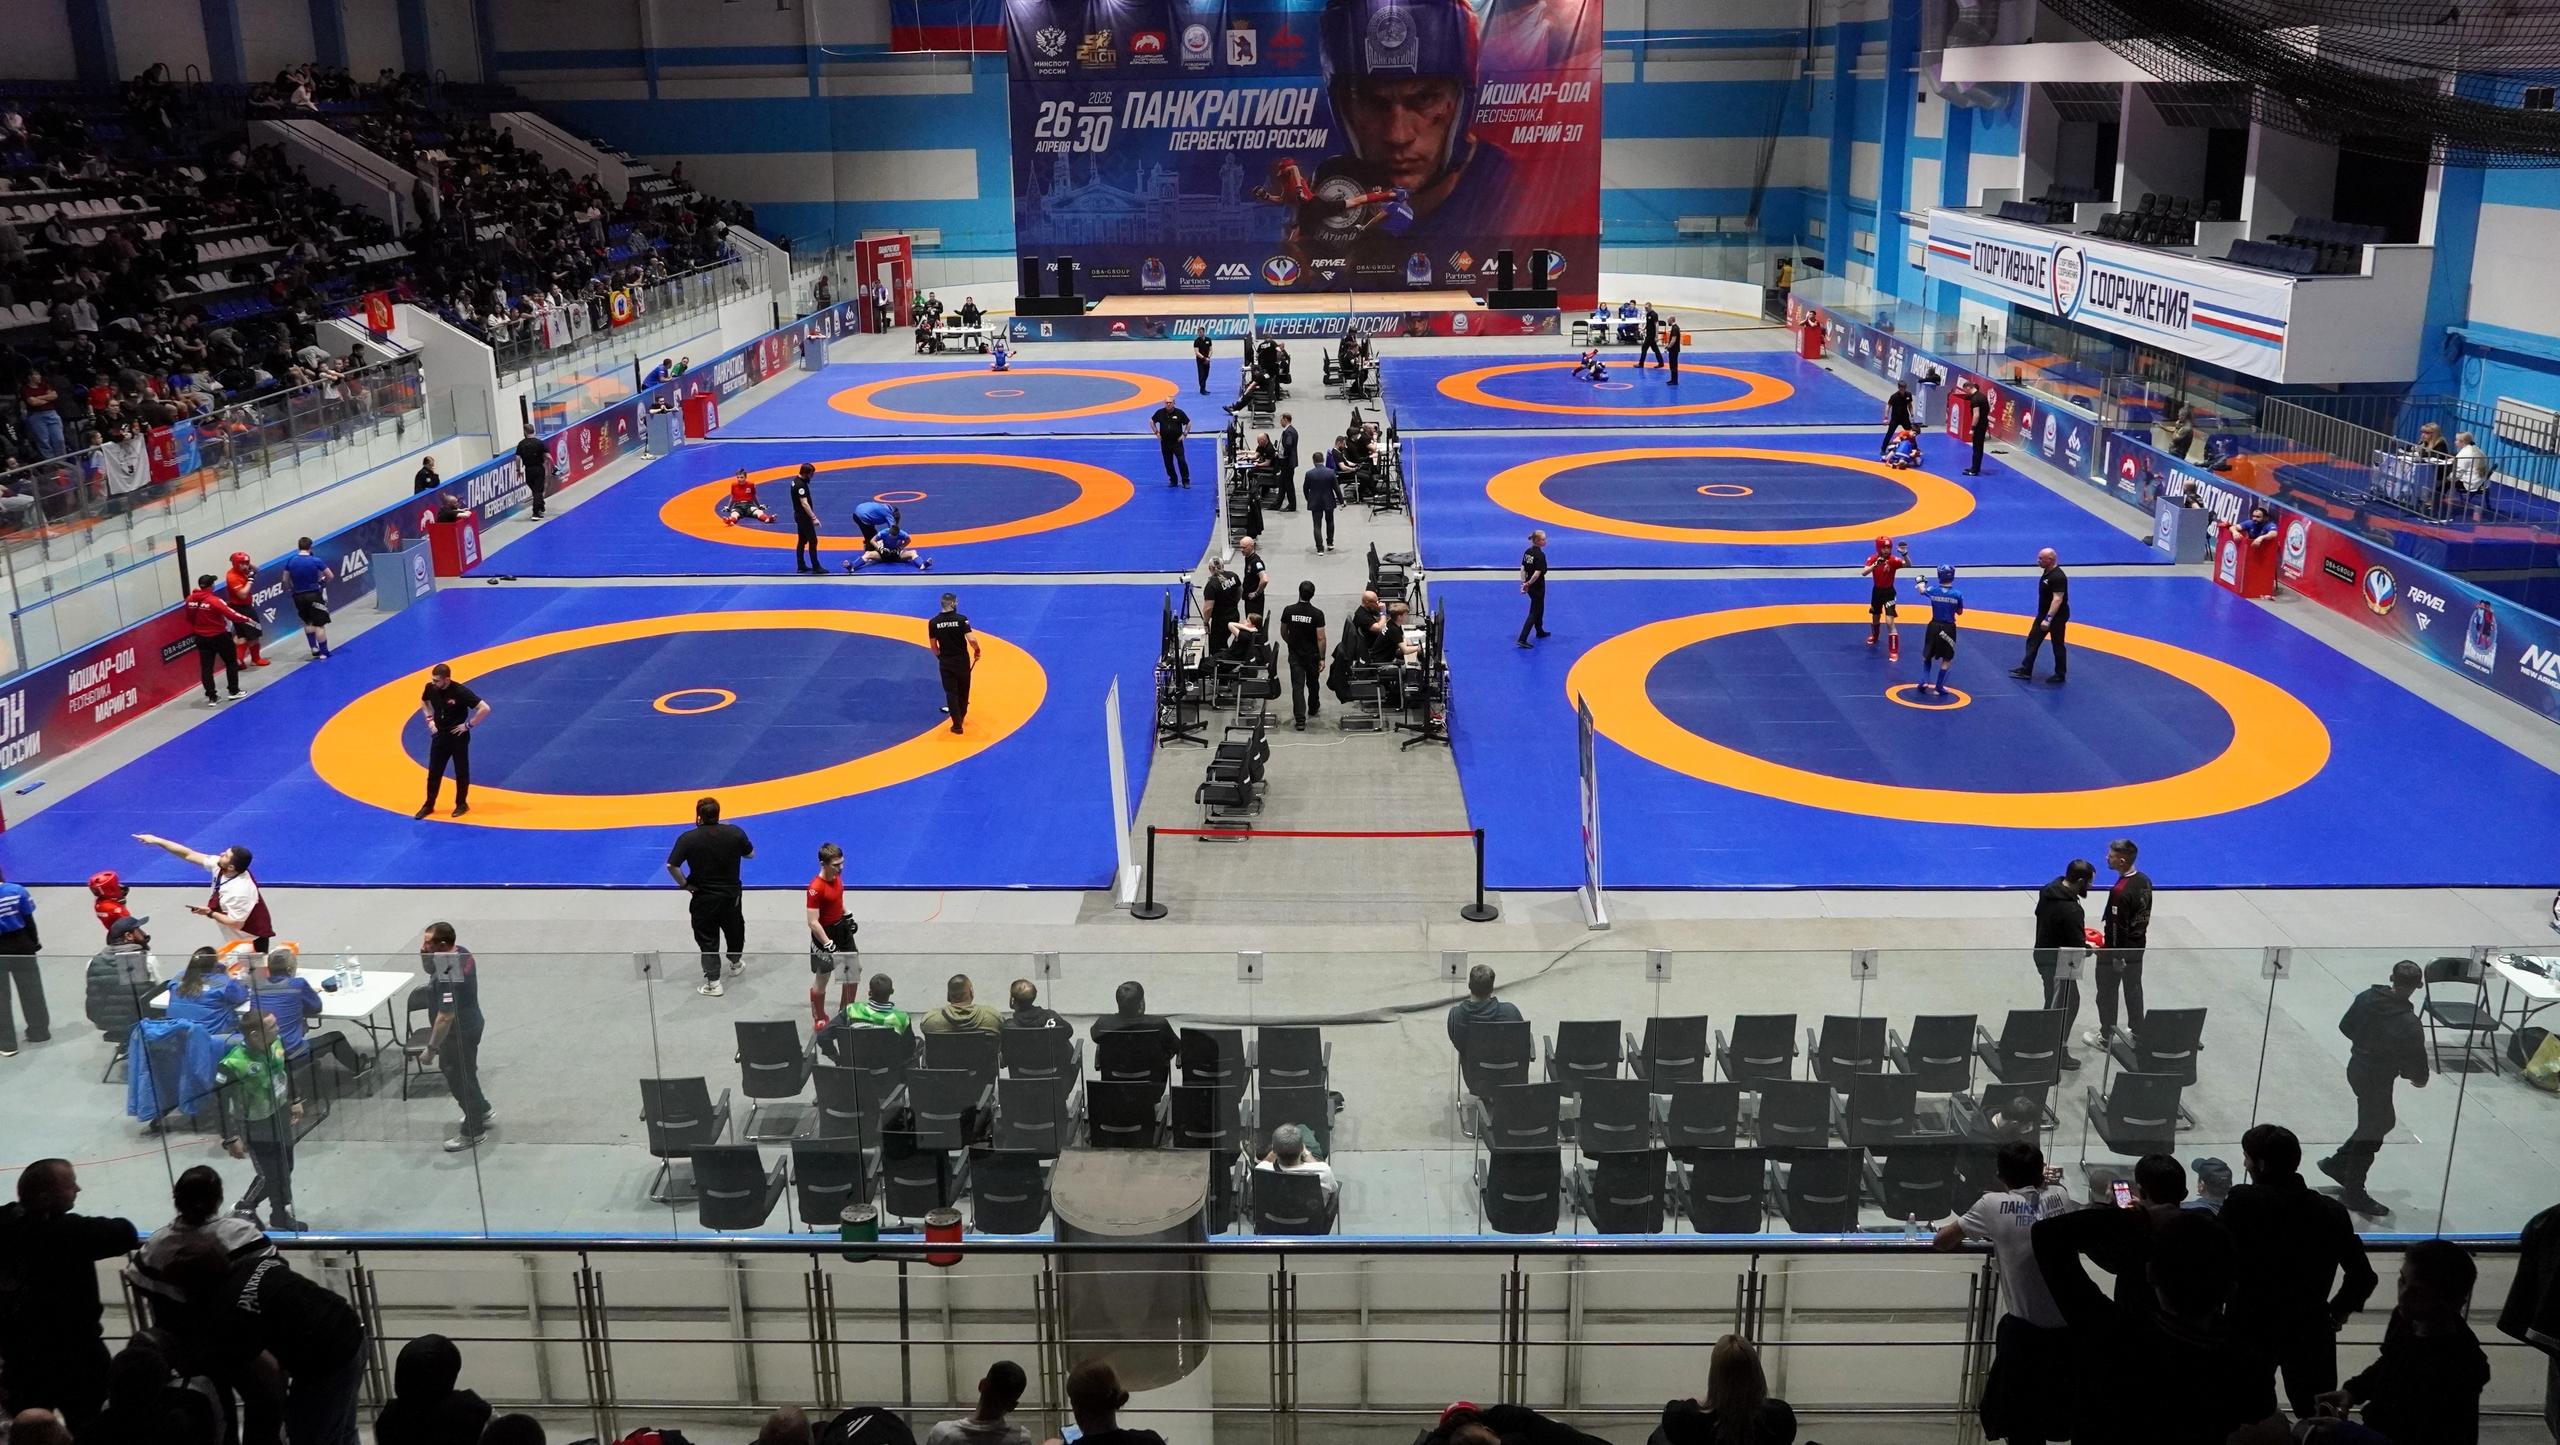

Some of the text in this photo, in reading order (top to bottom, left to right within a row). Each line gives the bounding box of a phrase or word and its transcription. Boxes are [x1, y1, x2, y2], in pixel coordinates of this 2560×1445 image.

[1088, 91, 1112, 104] 2026
[1480, 80, 1591, 105] ЙОШКАР-ОЛА
[1035, 101, 1074, 137] 26
[1121, 87, 1318, 128] ПАНКРАТИОН
[1475, 108, 1543, 123] РЕСПУБЛИКА
[1036, 140, 1071, 153] АПРЕЛЯ
[1073, 116, 1113, 153] 30
[1169, 128, 1328, 151] ПЕРВЕНСТВО РОССИИ
[1511, 123, 1560, 144] МАРИЙ
[1445, 272, 1476, 280] Partners
[1973, 240, 2047, 289] СПОРТИВНЫЕ
[1179, 277, 1211, 285] Partners
[2089, 270, 2190, 330] СООРУЖЕНИЯ
[1262, 317, 1344, 335] ПЕРВЕНСТВО
[1348, 315, 1399, 333] РОССИИ
[484, 491, 515, 519] ПЕРВЕНСТВО
[341, 548, 369, 577] NA
[68, 648, 136, 696] ЙОШКАР-ОЛА
[2520, 666, 2537, 679] NEW
[69, 682, 111, 714] РЕСПУБЛИКА
[95, 690, 125, 723] МАРИЙ
[0, 731, 41, 771] ОССИИ
